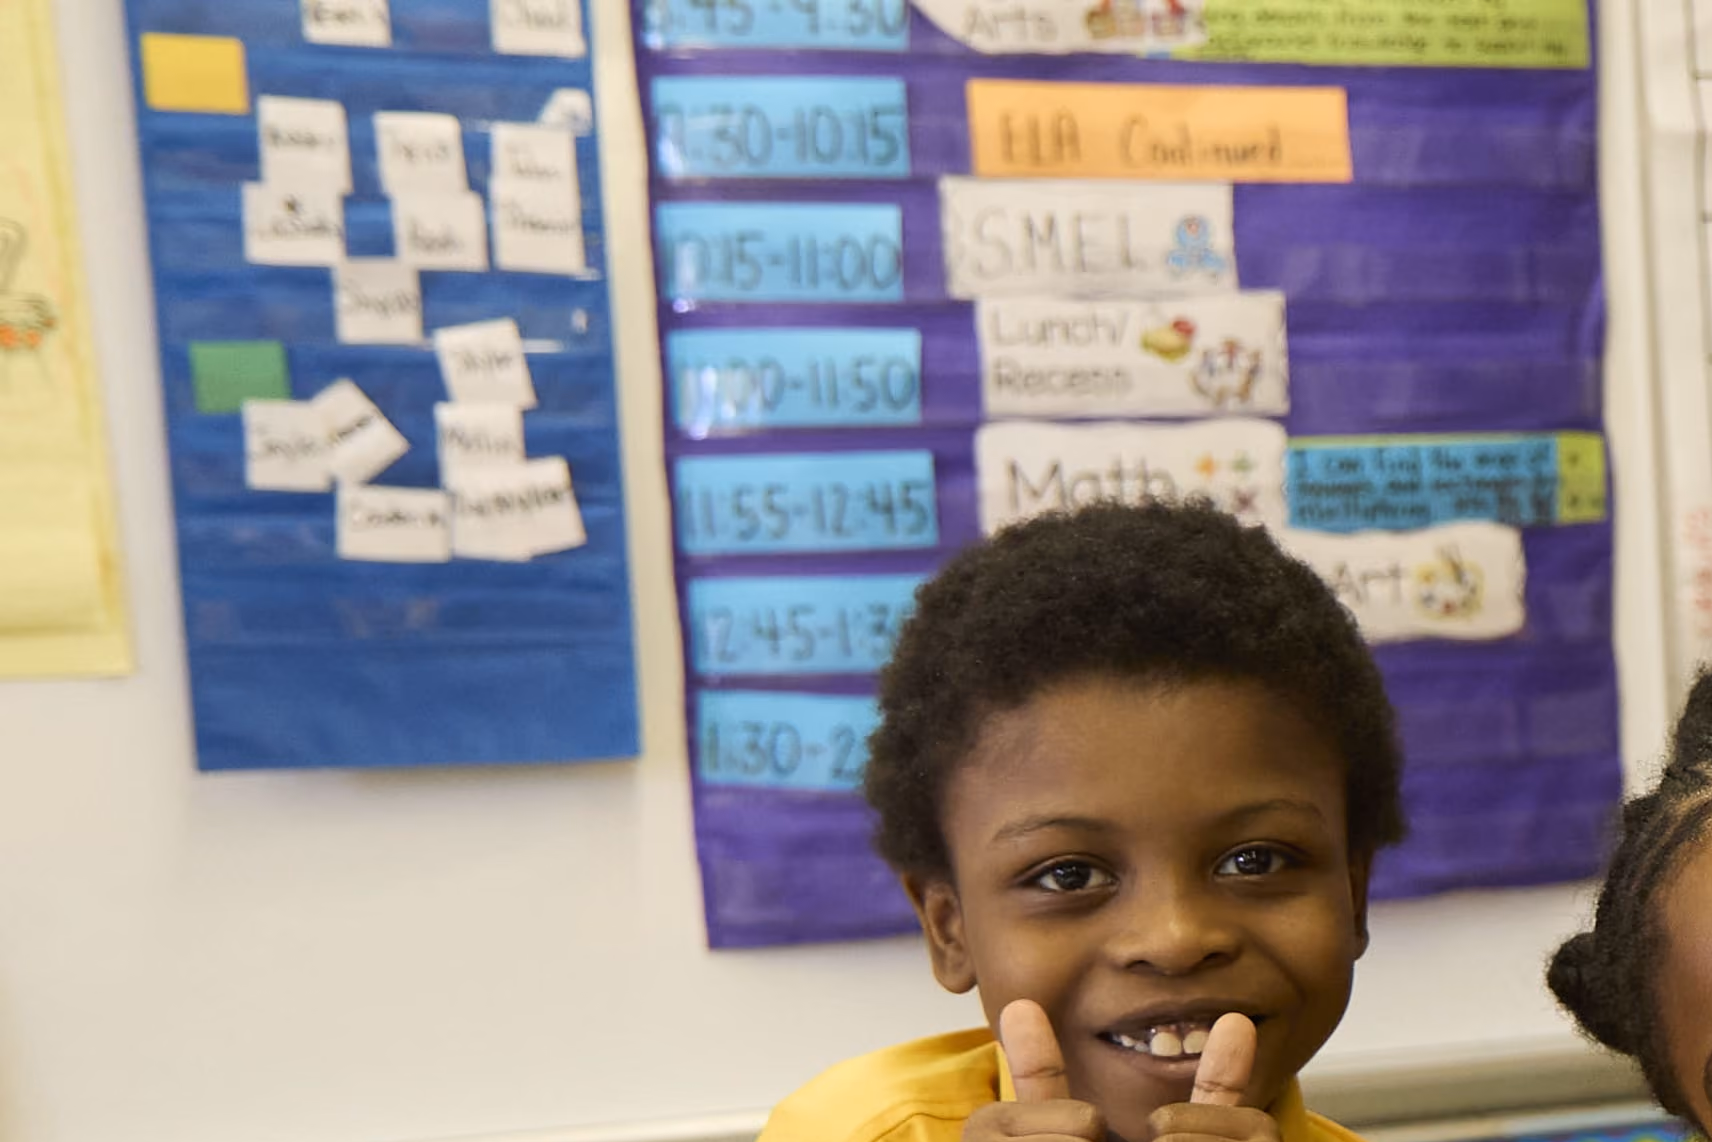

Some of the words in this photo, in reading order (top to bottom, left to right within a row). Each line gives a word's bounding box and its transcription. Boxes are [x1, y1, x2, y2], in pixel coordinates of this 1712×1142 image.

[1004, 453, 1178, 512] Math
[1332, 561, 1405, 607] Art
[691, 603, 902, 663] 12:45-1:3
